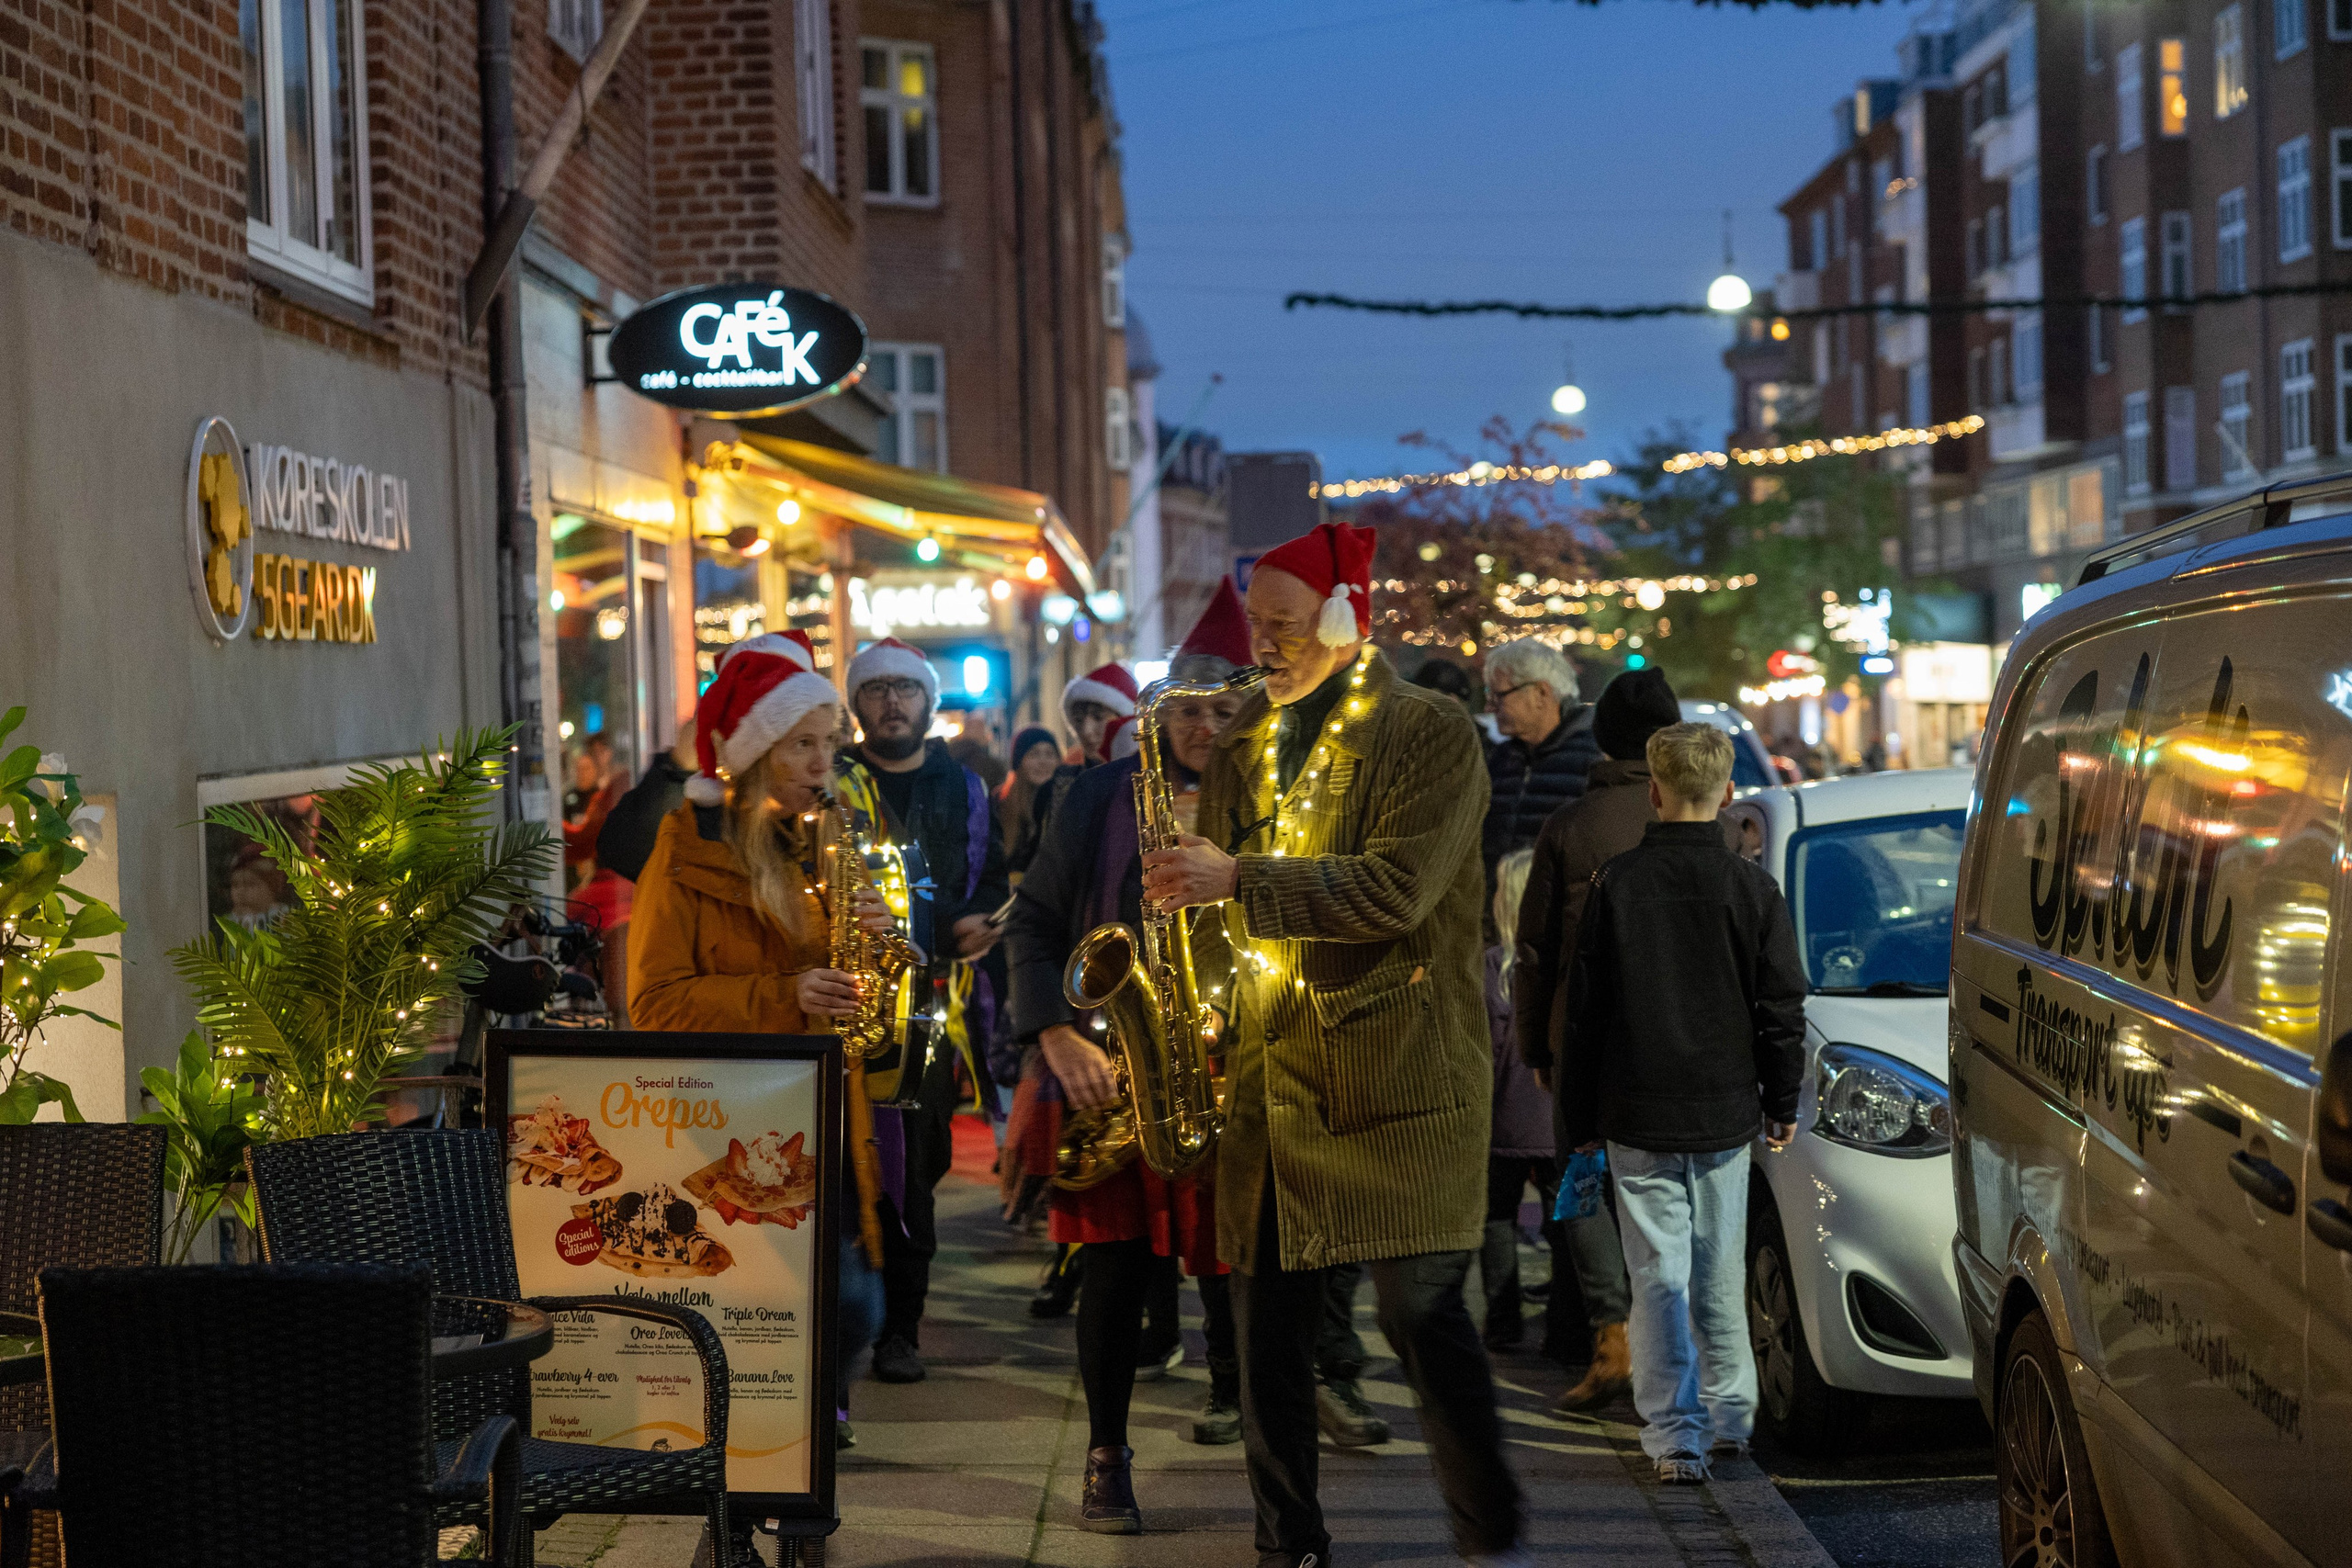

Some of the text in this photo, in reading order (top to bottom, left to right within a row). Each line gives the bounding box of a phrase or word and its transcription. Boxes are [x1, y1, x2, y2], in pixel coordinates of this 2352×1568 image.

[250, 442, 411, 551] KØRESKOLEN
[254, 553, 377, 643] 5GEAR.DK
[2016, 963, 2119, 1113] Transport
[635, 1076, 714, 1090] Special Edition
[600, 1082, 729, 1149] Crepes
[559, 1226, 594, 1247] Special
[564, 1242, 600, 1258] editions
[657, 1287, 714, 1307] mellem
[571, 1310, 595, 1324] Vida
[721, 1306, 797, 1325] Triple Dream
[630, 1325, 657, 1340] Oreo
[583, 1368, 619, 1382] 4-ever
[770, 1370, 795, 1383] Love
